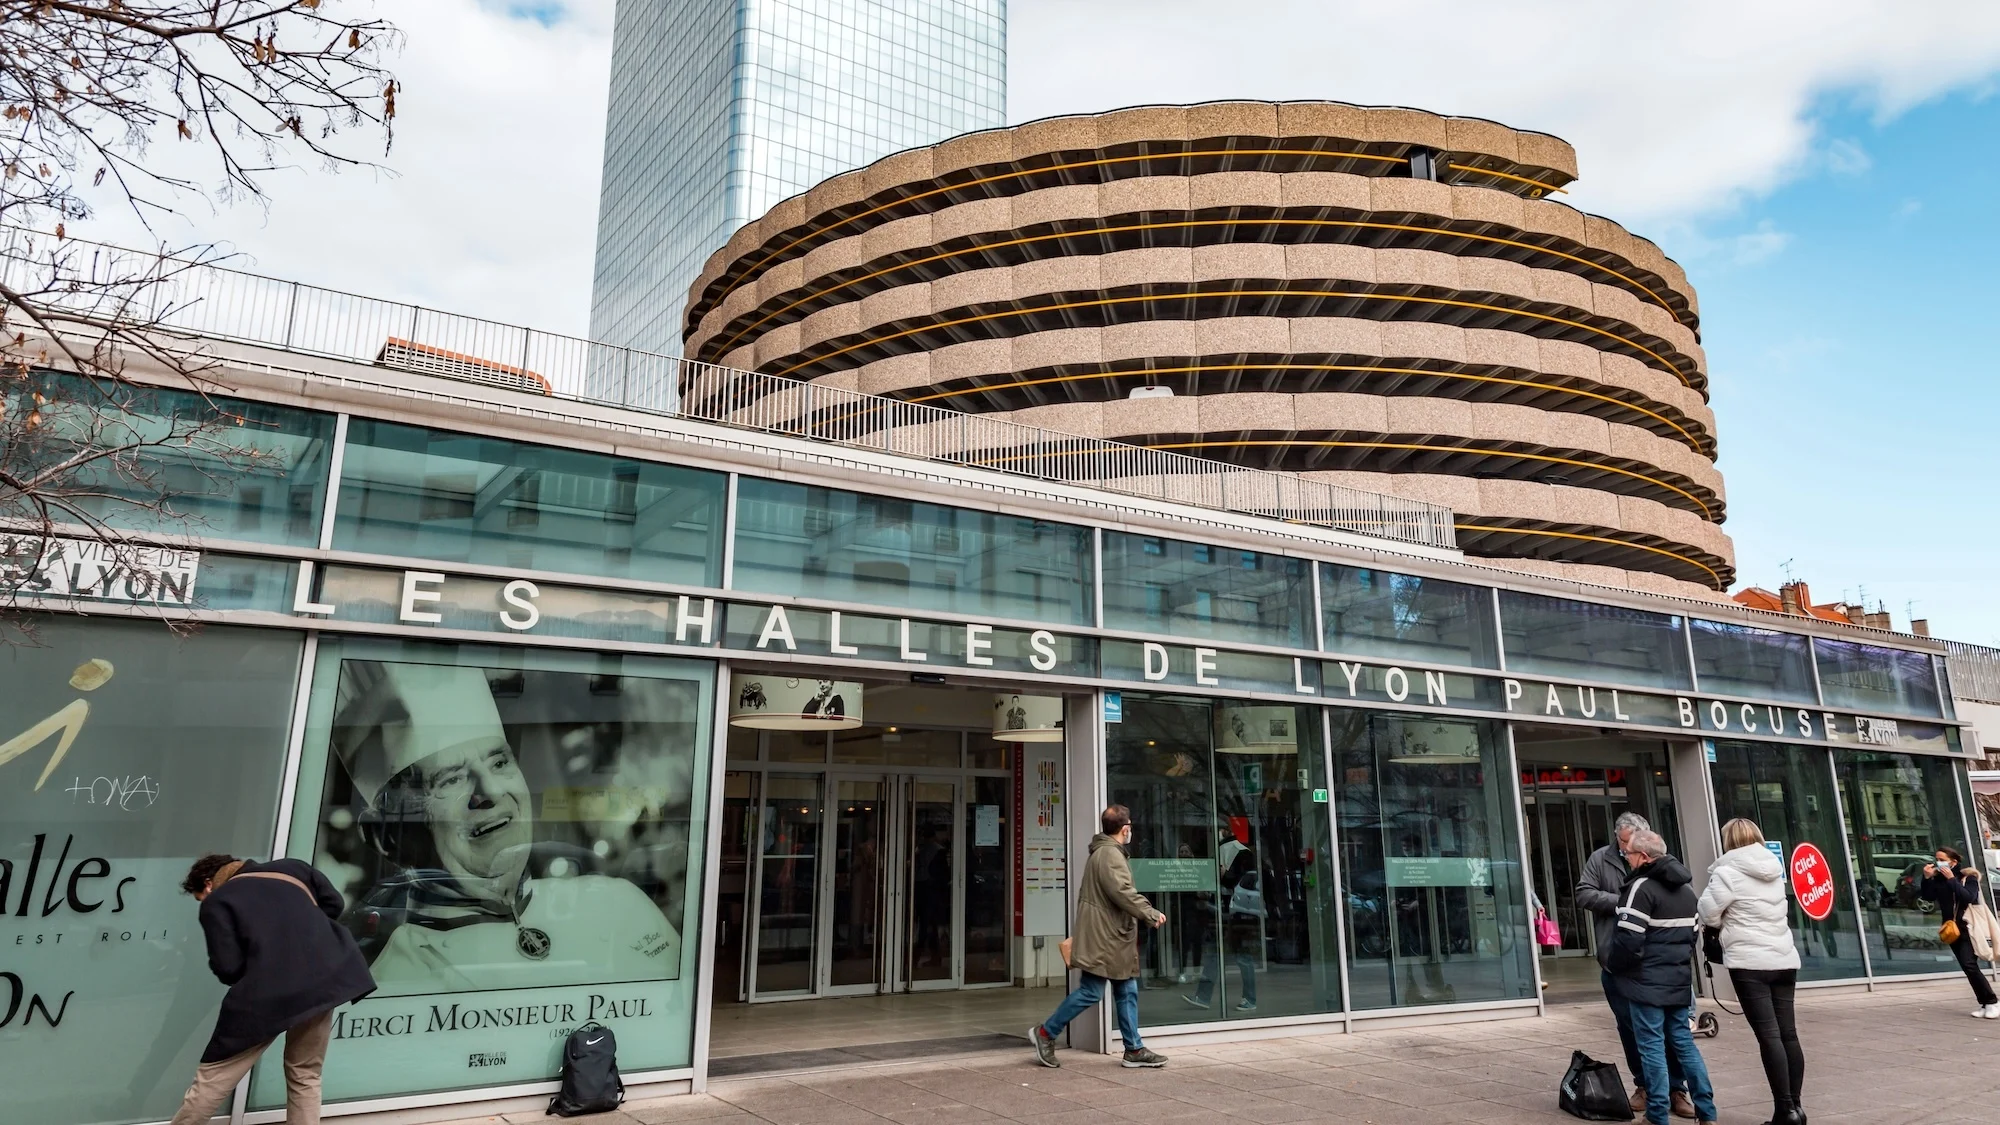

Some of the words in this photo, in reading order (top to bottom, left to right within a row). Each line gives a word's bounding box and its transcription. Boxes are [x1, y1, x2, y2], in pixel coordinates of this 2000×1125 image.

[159, 549, 194, 570] DE
[70, 563, 190, 603] LYON
[293, 560, 540, 630] LES
[675, 595, 1057, 671] HALLES
[1143, 642, 1219, 686] DE
[1294, 657, 1448, 706] LYON
[1504, 679, 1630, 722] PAUL
[1679, 696, 1838, 741] BOCUSE
[1873, 729, 1900, 746] LYON
[1795, 853, 1817, 875] Click
[1806, 872, 1815, 885] &
[1802, 879, 1832, 907] Collect
[16, 933, 64, 945] EST
[424, 1003, 574, 1033] MONSIEUR
[587, 994, 653, 1020] PAUL
[484, 1057, 507, 1066] LYON
